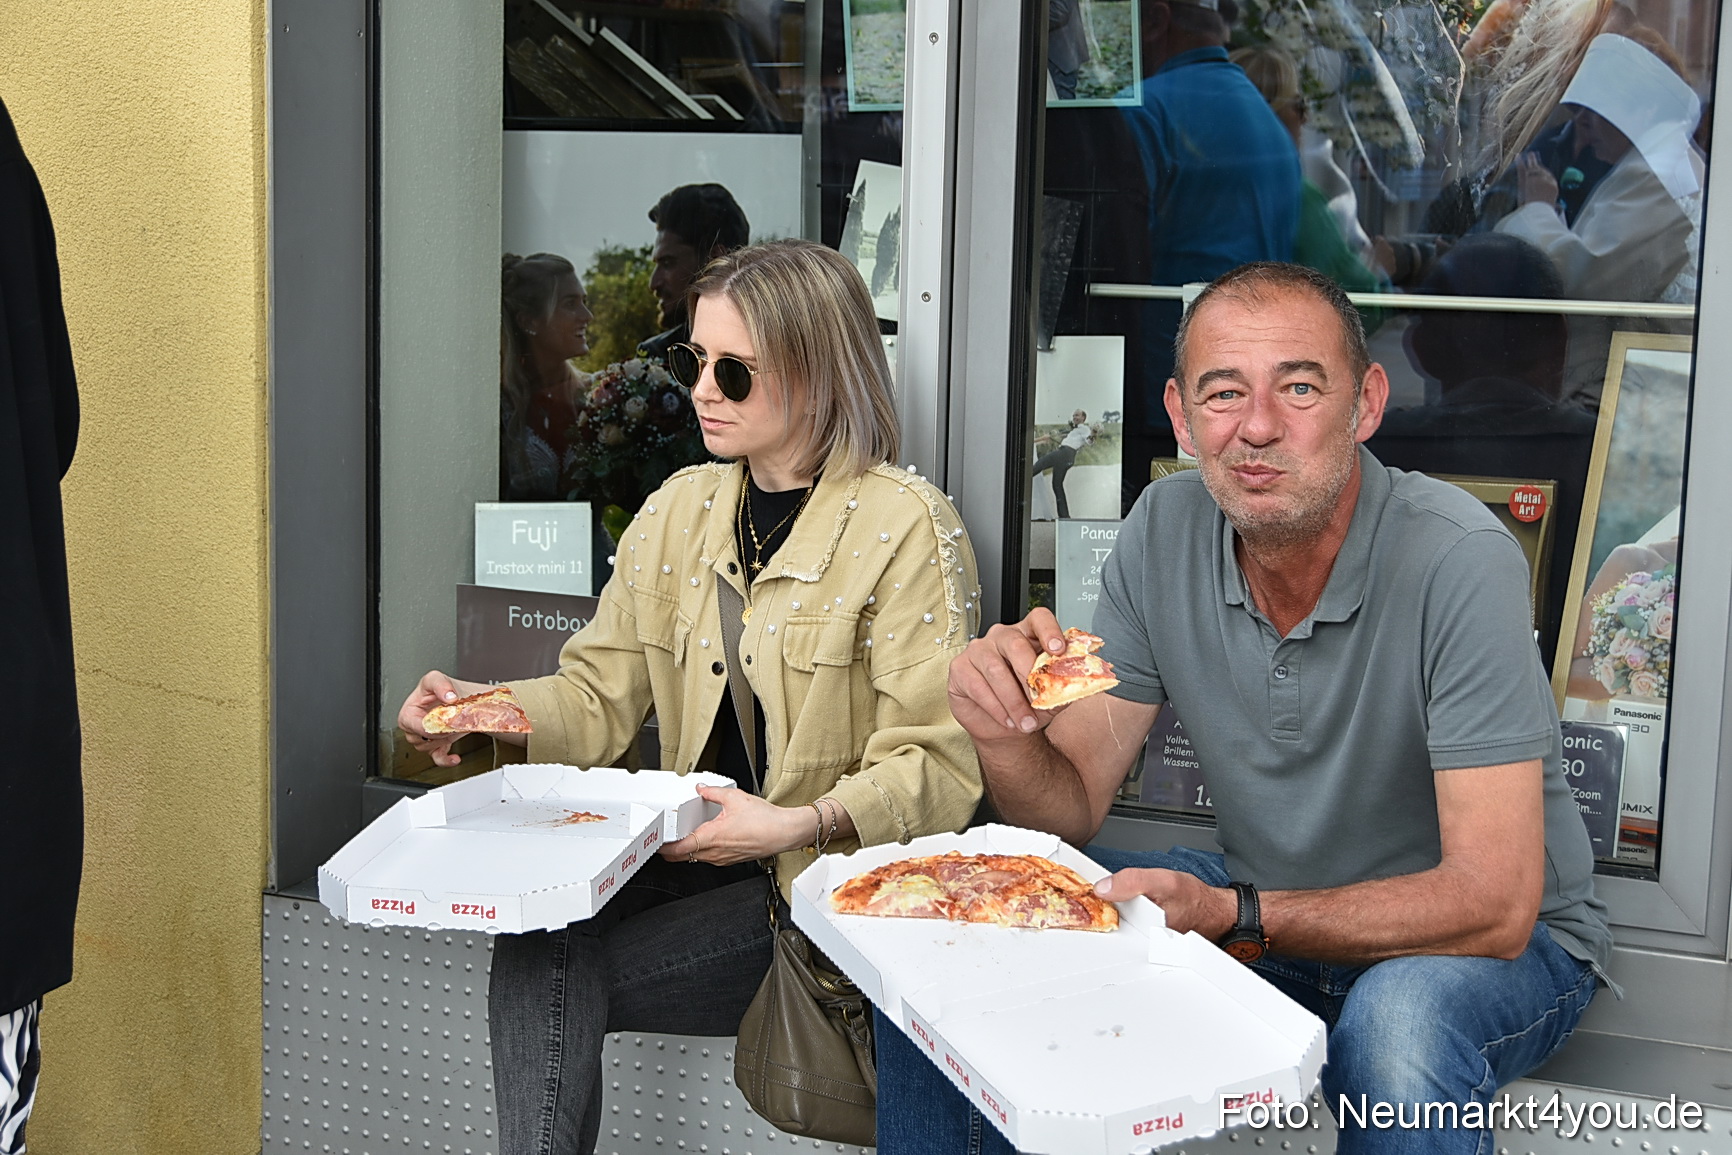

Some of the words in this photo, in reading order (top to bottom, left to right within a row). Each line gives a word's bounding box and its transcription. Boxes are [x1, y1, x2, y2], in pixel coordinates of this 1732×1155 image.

[1514, 491, 1542, 505] Metal
[1518, 504, 1535, 516] Art
[512, 520, 558, 551] Fuji
[486, 560, 534, 575] Instax
[537, 560, 566, 575] mini
[569, 560, 583, 574] 11
[1613, 706, 1663, 721] Panasonic
[1571, 786, 1602, 801] Zoom
[643, 826, 659, 850] Pizza
[621, 849, 638, 873] Pizza
[598, 871, 615, 896] Pizza
[371, 898, 416, 915] Pizza
[451, 903, 497, 920] Pizza
[910, 1017, 936, 1053] Pizza
[944, 1052, 971, 1088] Pizza
[980, 1087, 1007, 1125] Pizza
[1132, 1112, 1184, 1136] Pizza
